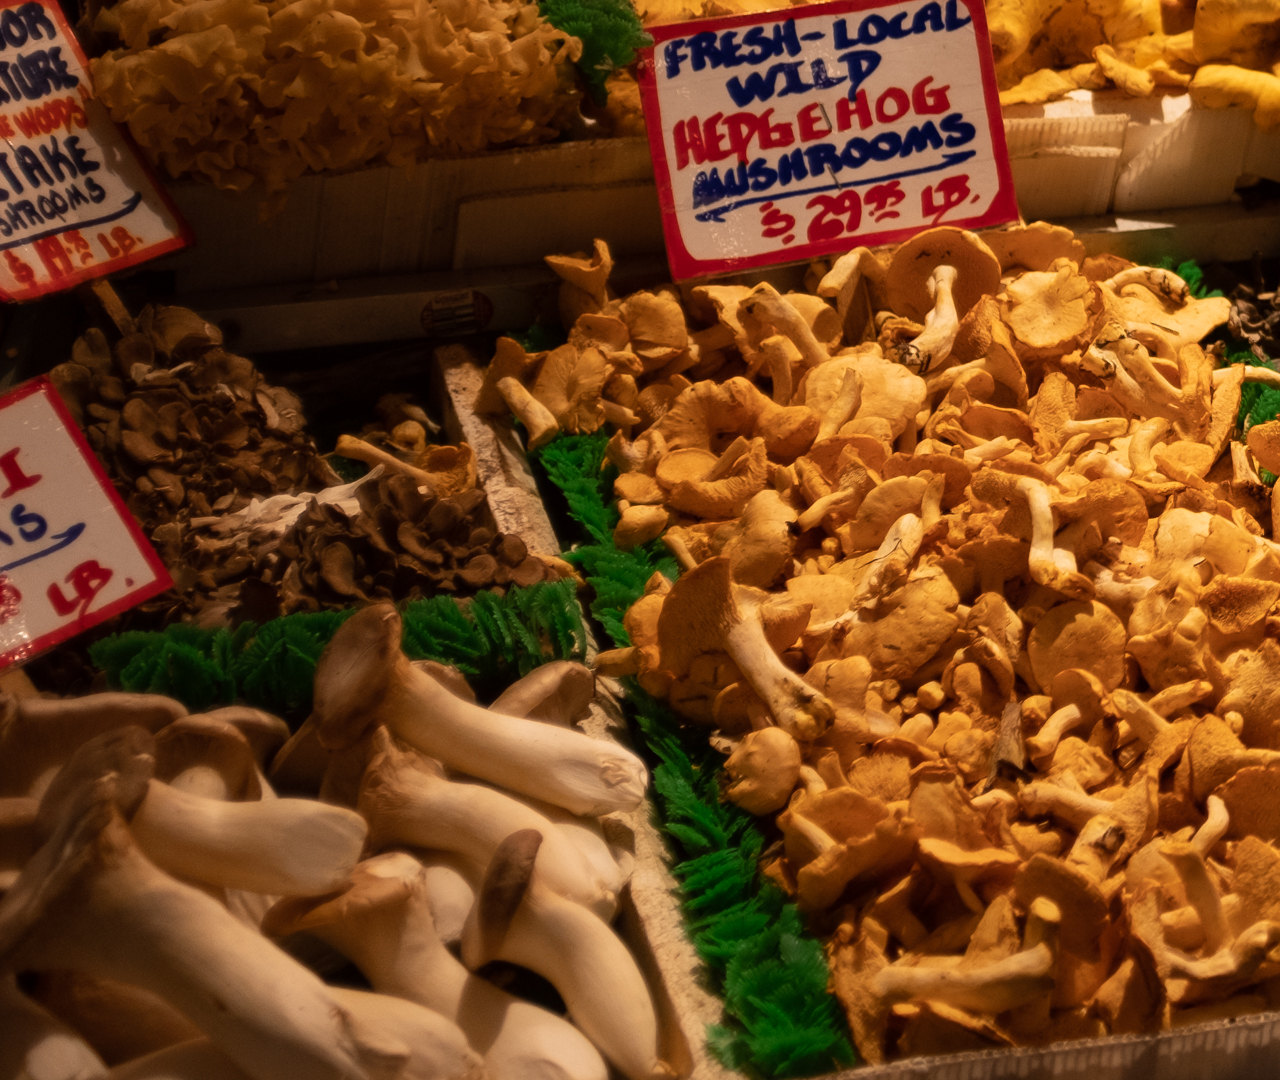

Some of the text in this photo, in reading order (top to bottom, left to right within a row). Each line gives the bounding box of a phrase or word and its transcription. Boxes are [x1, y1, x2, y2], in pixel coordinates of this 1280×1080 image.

[672, 75, 951, 171] HEDGEHOG
[725, 49, 882, 108] WILD
[692, 112, 977, 210] MUSHROOMS
